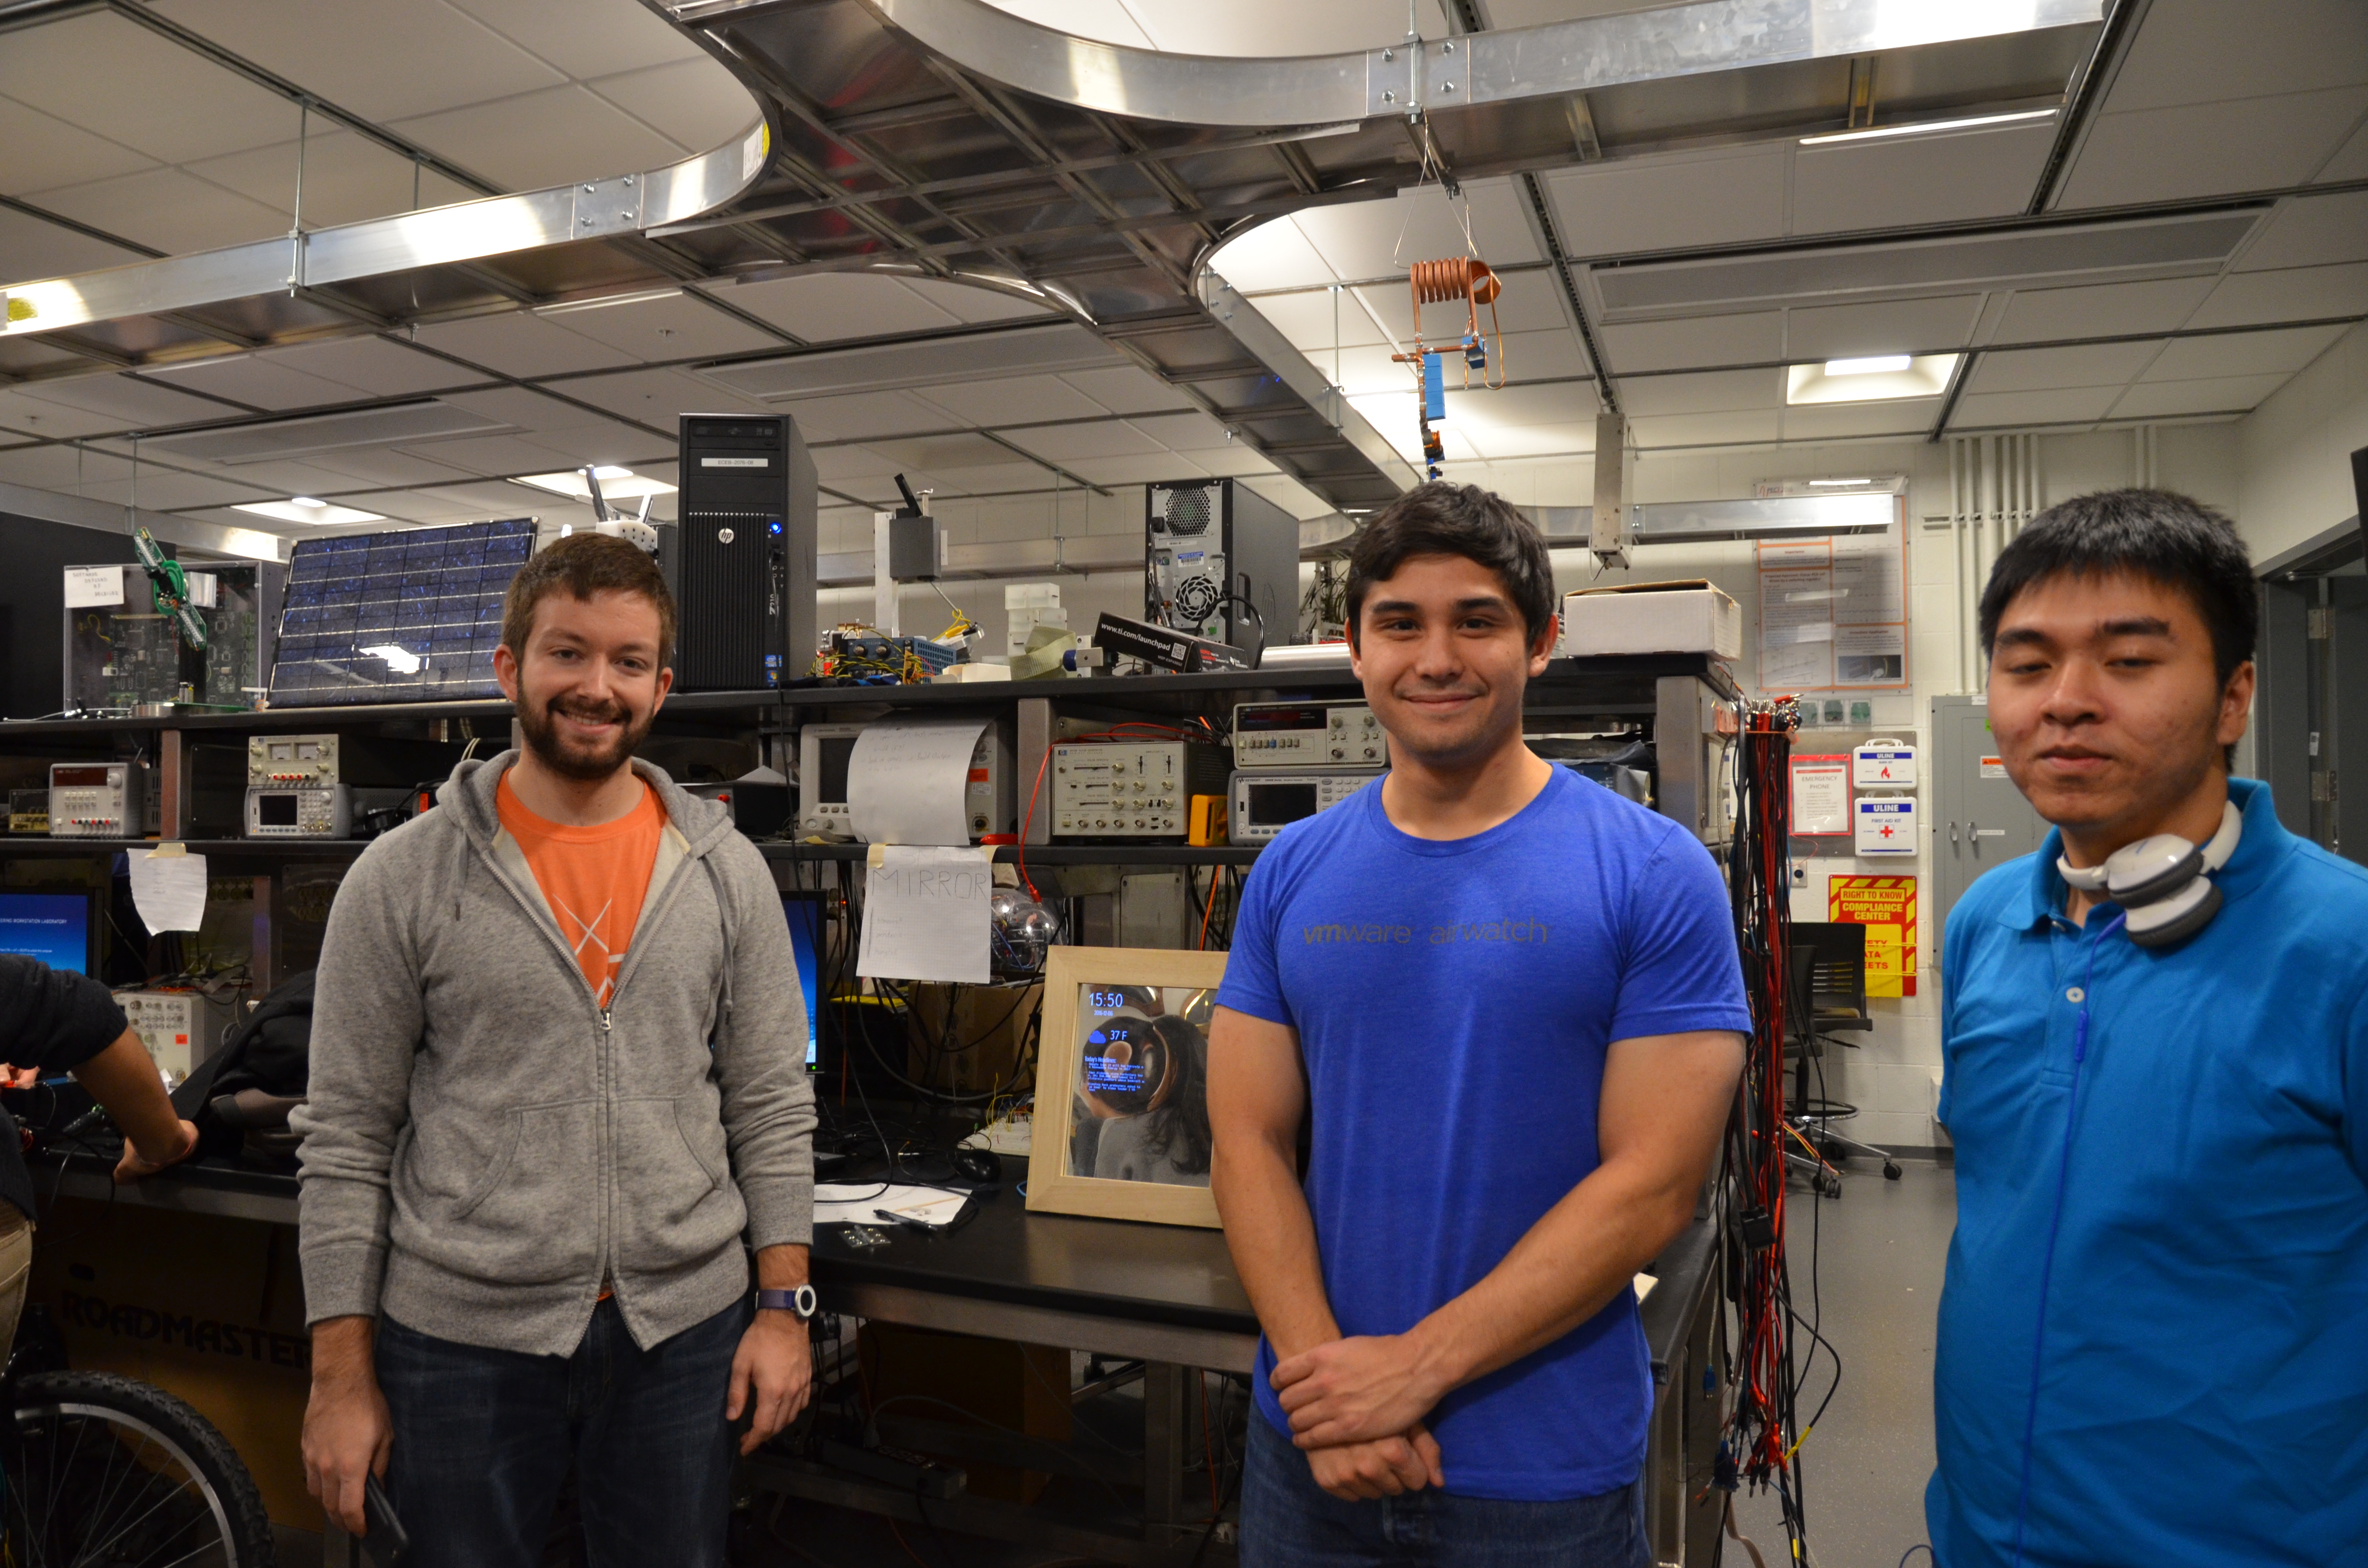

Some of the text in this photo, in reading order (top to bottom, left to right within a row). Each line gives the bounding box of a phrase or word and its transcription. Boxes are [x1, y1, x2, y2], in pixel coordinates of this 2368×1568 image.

[721, 528, 732, 543] hp
[1101, 623, 1171, 651] www.ti.com/launchpad
[1873, 804, 1899, 812] ULINE
[872, 869, 988, 901] MIRROR
[1843, 891, 1865, 899] RIGHT
[1879, 891, 1902, 899] KNOW
[1842, 903, 1903, 912] COMPLIANCE
[1854, 911, 1891, 920] CENTER
[1305, 918, 1547, 945] vmware airwatch
[1089, 992, 1123, 1008] 15:50
[1110, 1030, 1128, 1041] 37 F
